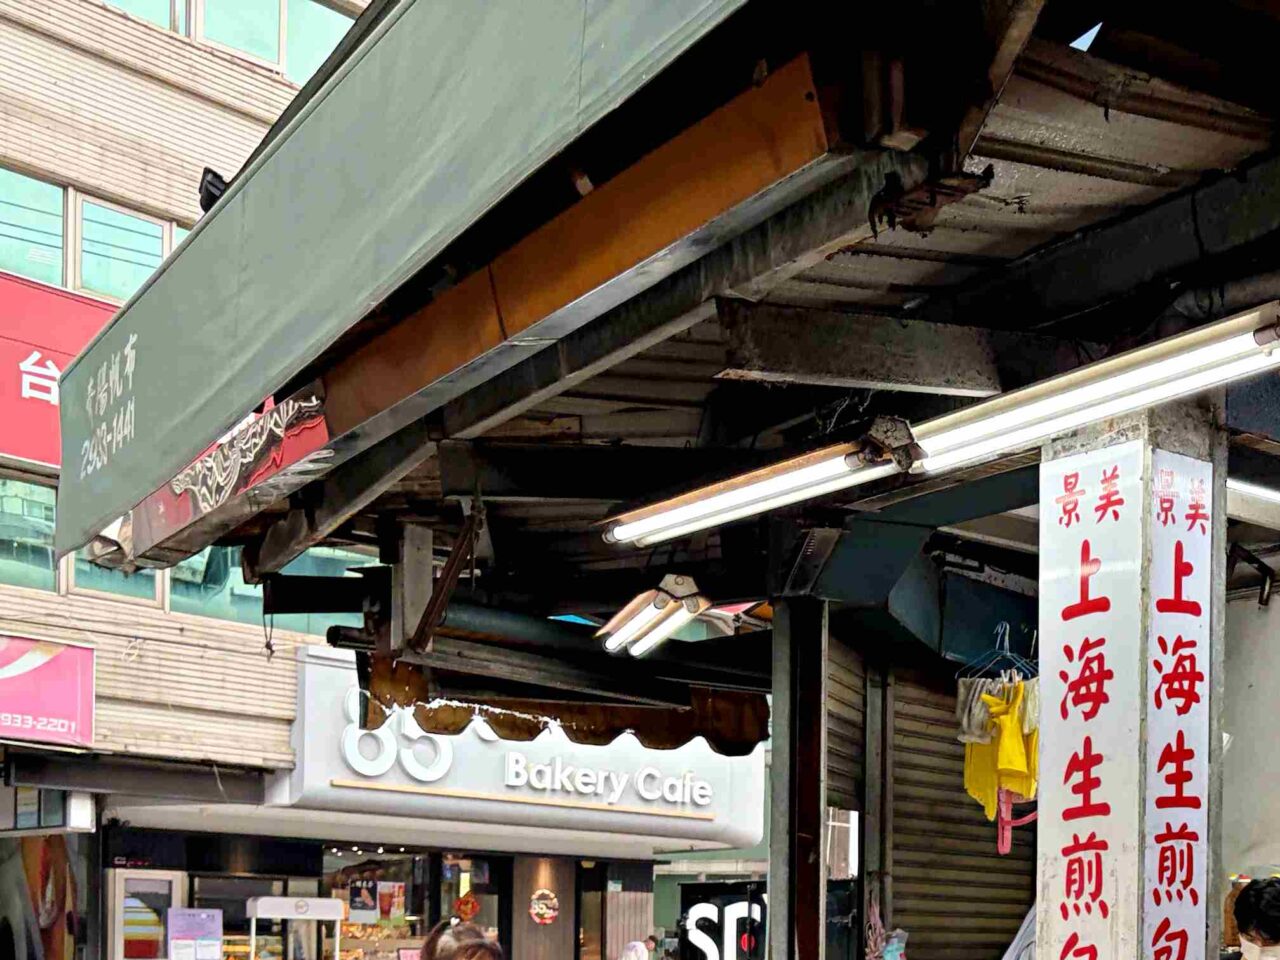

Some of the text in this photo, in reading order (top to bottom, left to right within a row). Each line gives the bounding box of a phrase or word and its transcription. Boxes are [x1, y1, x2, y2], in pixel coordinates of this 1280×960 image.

[19, 350, 62, 406] 台
[1055, 465, 1125, 529] 景美
[504, 751, 713, 806] Bakery Cafe
